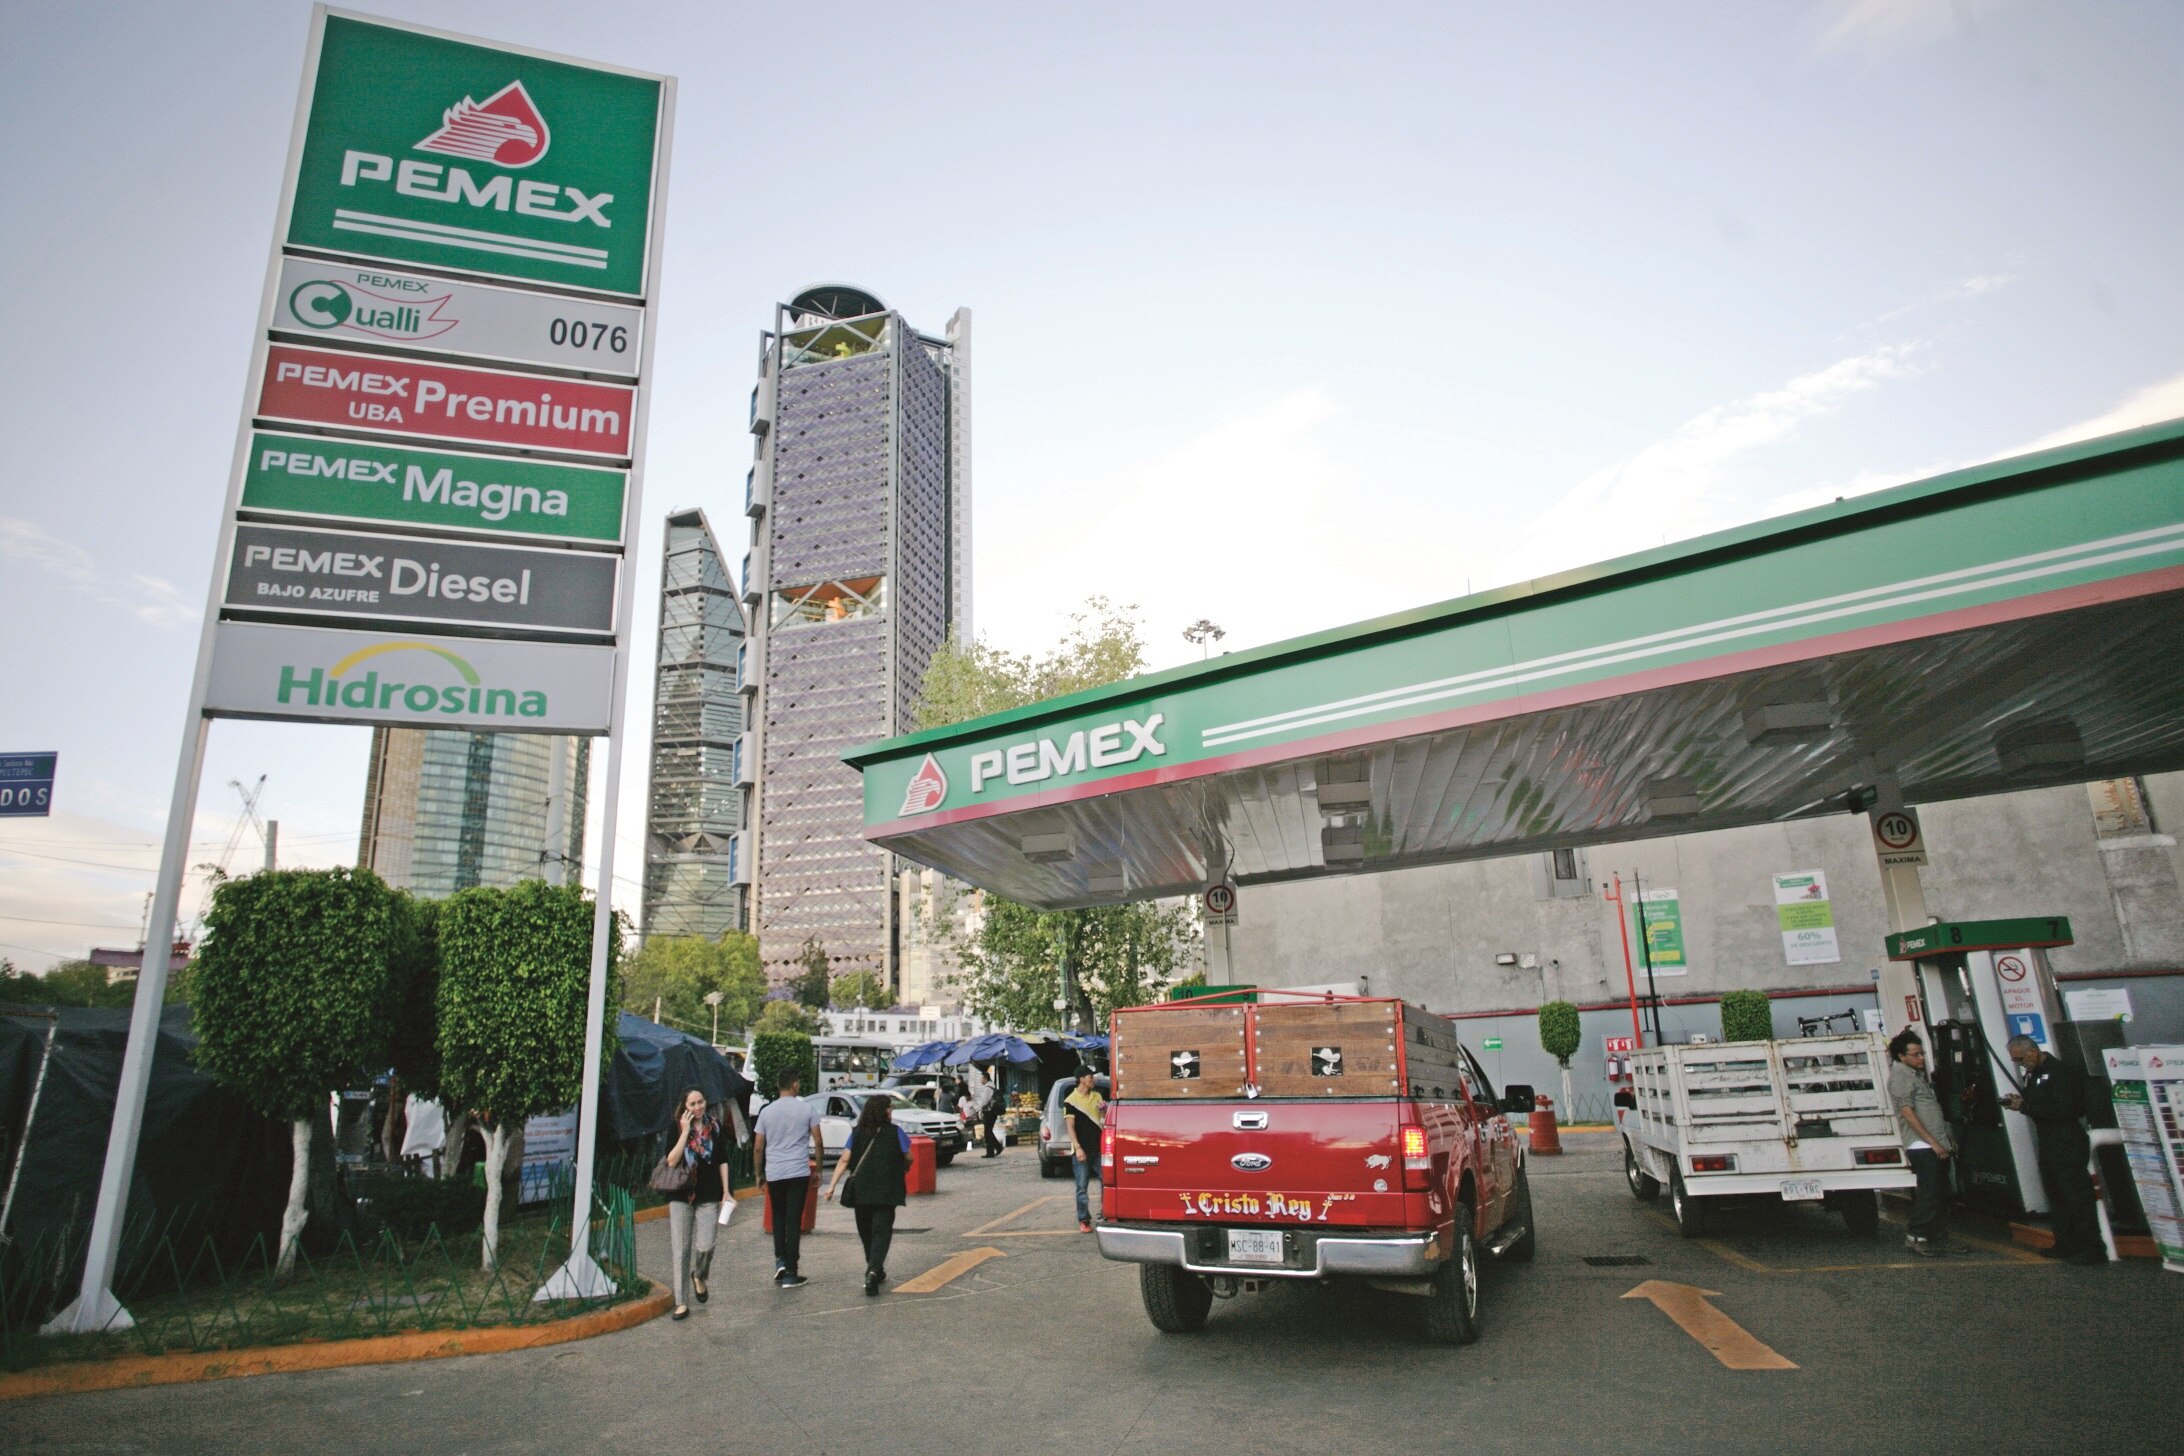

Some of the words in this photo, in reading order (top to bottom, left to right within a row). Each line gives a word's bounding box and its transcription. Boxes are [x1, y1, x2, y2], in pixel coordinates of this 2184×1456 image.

[340, 149, 614, 228] PEMEX
[357, 273, 429, 294] PEMEX
[549, 317, 628, 354] 0076
[276, 361, 410, 397] PEMEX
[414, 379, 620, 436] Premium
[348, 401, 404, 424] UBA
[260, 449, 398, 484] PEMEX
[402, 465, 569, 520] Magna
[245, 544, 384, 578] PEMEX
[389, 557, 531, 605] Diesel
[257, 582, 305, 599] BAJO
[310, 585, 380, 603] AZUFRE
[276, 664, 548, 718] Hidrosina
[970, 712, 1167, 794] PEMEX
[1885, 819, 1908, 836] 10
[1884, 856, 1921, 865] MAXIMA
[1212, 891, 1228, 903] 10
[1950, 926, 1962, 944] 8
[2047, 920, 2058, 939] 7
[1239, 1156, 1262, 1168] Ford
[1198, 1191, 1260, 1218] Cristo
[1265, 1191, 1312, 1222] Rey
